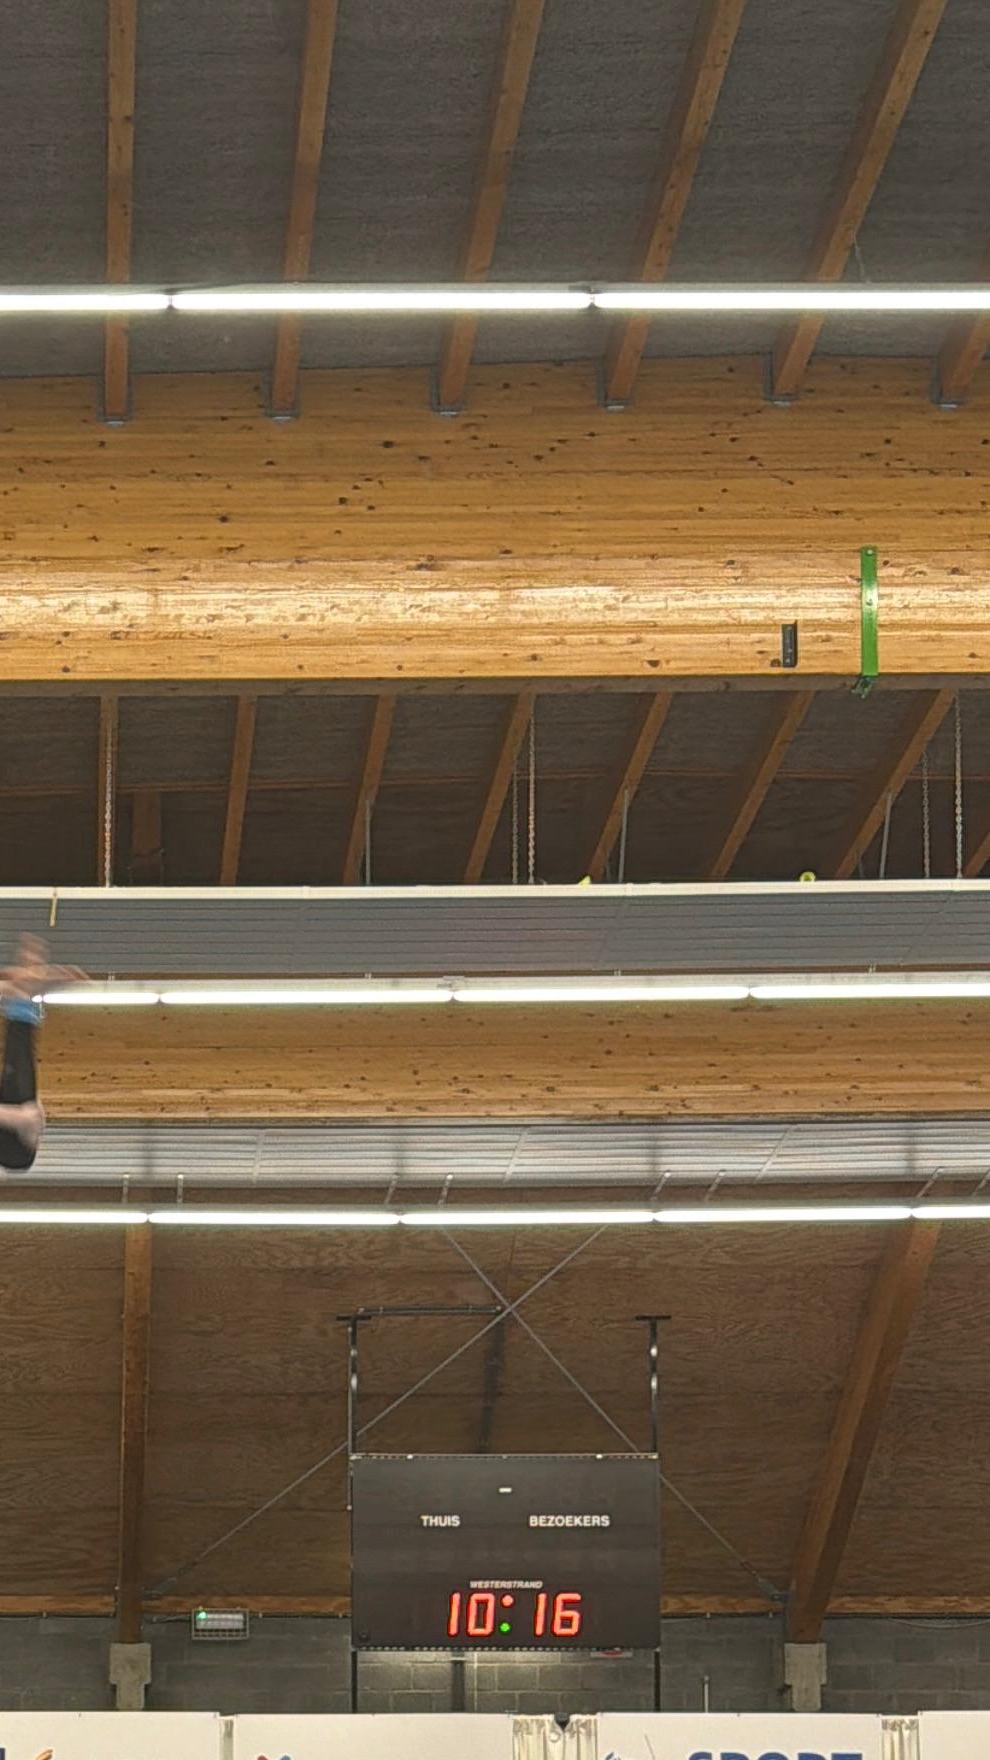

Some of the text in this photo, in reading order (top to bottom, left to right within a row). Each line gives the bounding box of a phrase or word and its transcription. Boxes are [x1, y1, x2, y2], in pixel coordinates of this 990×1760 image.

[420, 1516, 460, 1527] THUIS
[529, 1516, 610, 1527] BEZOEKERS
[470, 1580, 543, 1589] WESTERSTRAND
